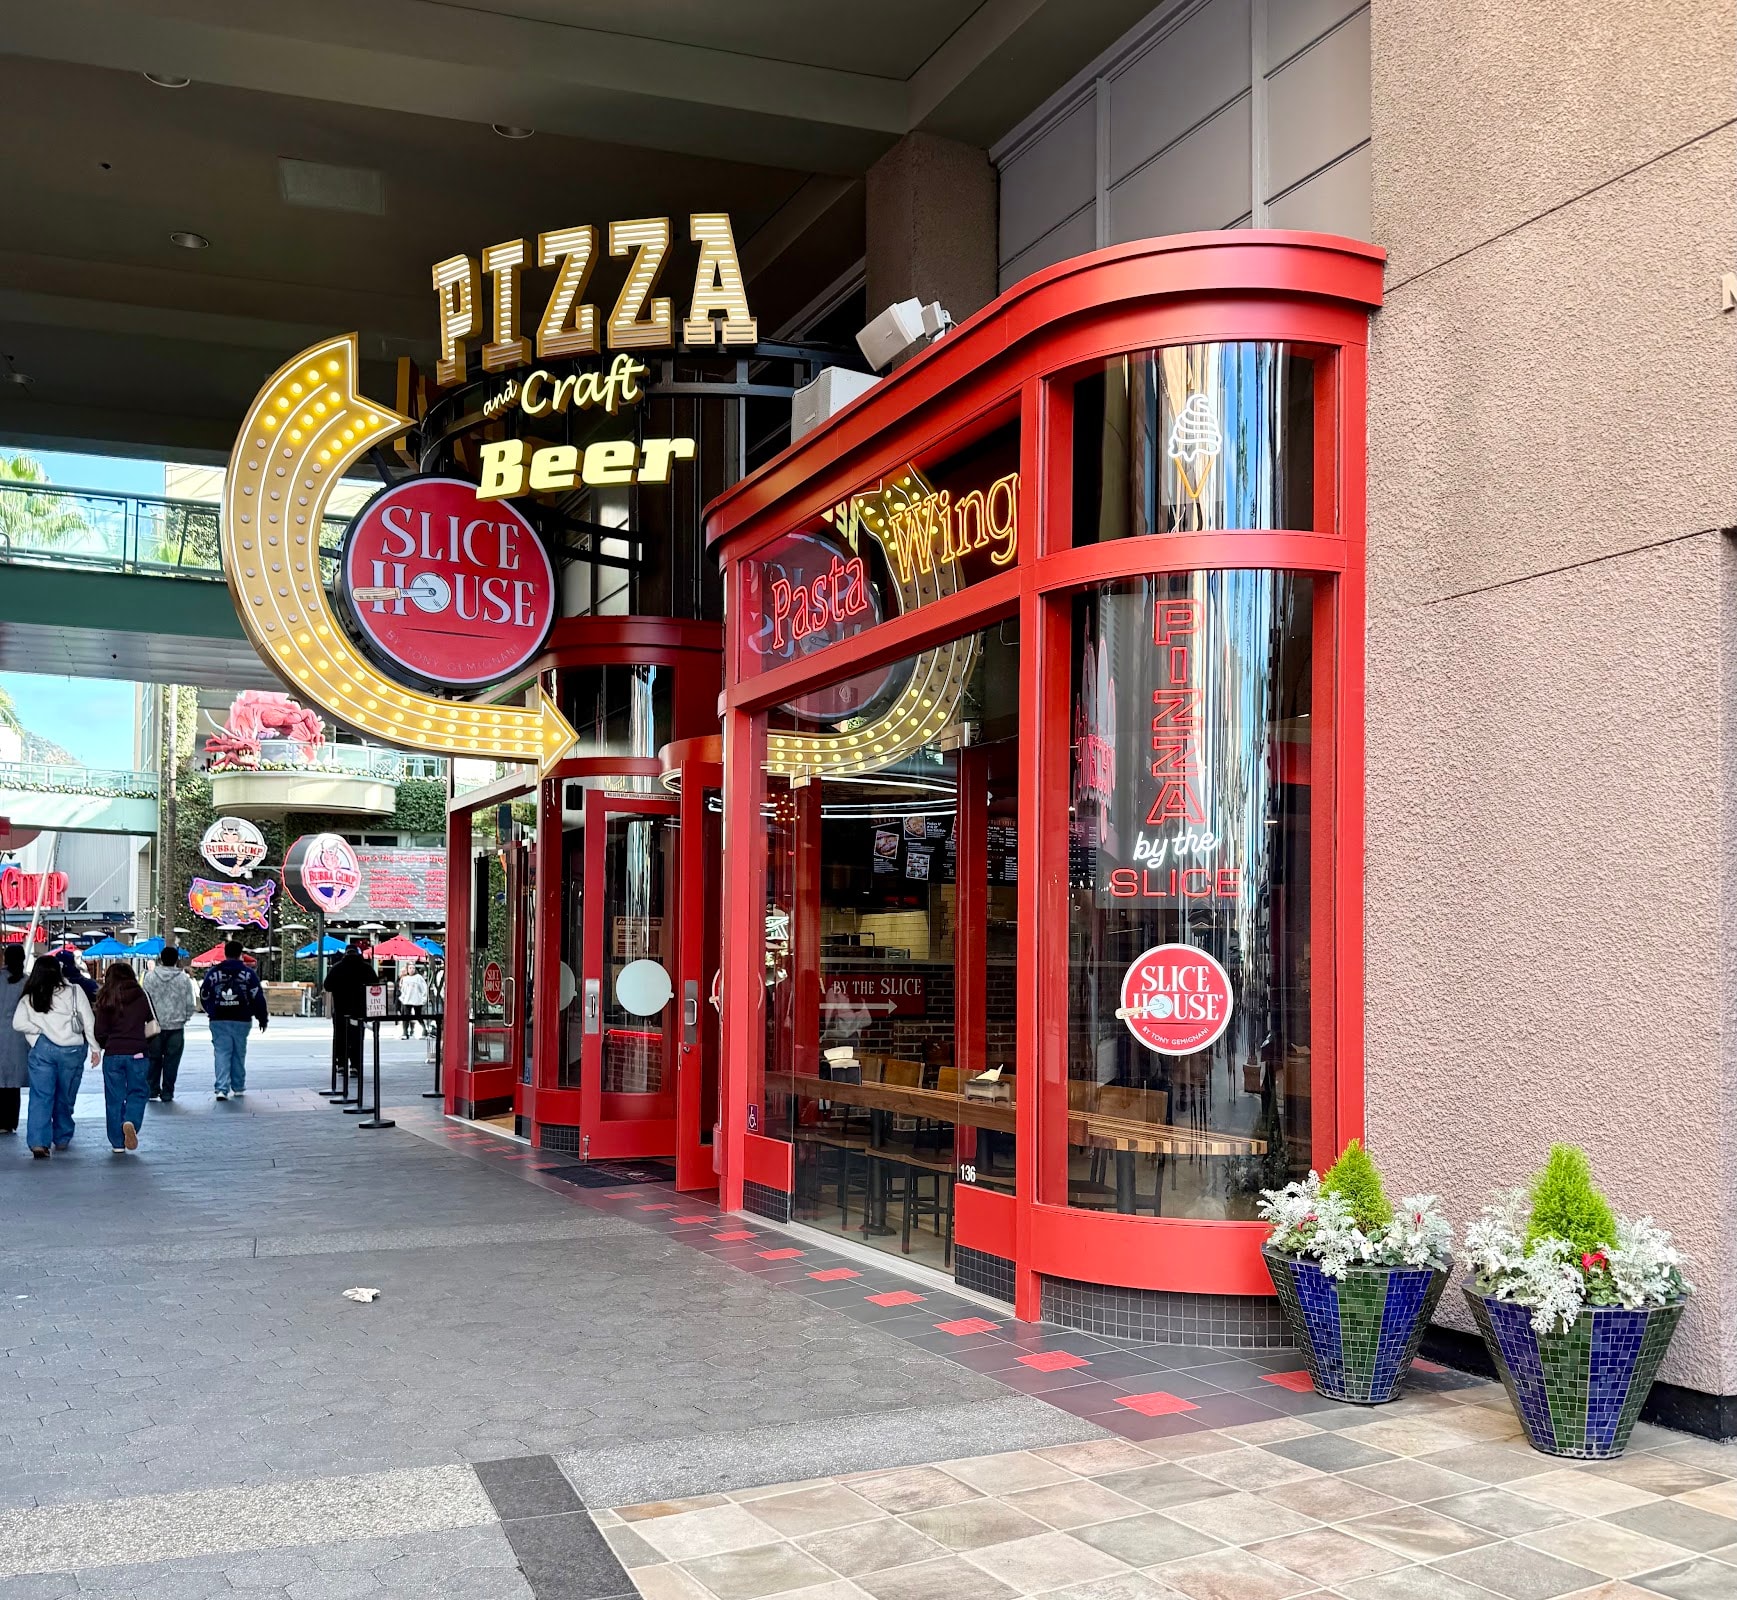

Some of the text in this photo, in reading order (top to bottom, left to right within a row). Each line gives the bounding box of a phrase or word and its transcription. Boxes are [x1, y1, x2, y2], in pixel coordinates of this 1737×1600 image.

[432, 213, 758, 385] PIZZA
[482, 353, 650, 417] and Craft
[475, 436, 697, 500] Beer
[381, 505, 520, 570] SLICE
[888, 472, 1021, 584] Wing
[370, 559, 535, 627] HOUSE
[771, 555, 867, 650] Pasta
[406, 645, 440, 669] TONY
[1146, 599, 1206, 825] PIZZA
[205, 843, 263, 856] BUBBA GUMP
[1132, 826, 1222, 869] by the
[1, 867, 68, 908] GUMP
[309, 870, 357, 885] BUBBA GUMP
[1109, 868, 1241, 897] SLICE
[833, 980, 848, 995] BY
[852, 980, 875, 995] THE
[880, 978, 922, 996] SLICE
[1140, 965, 1210, 993] SLICE
[1142, 1025, 1210, 1047] BY TONY GEMIGNANI
[960, 1163, 976, 1183] 136
